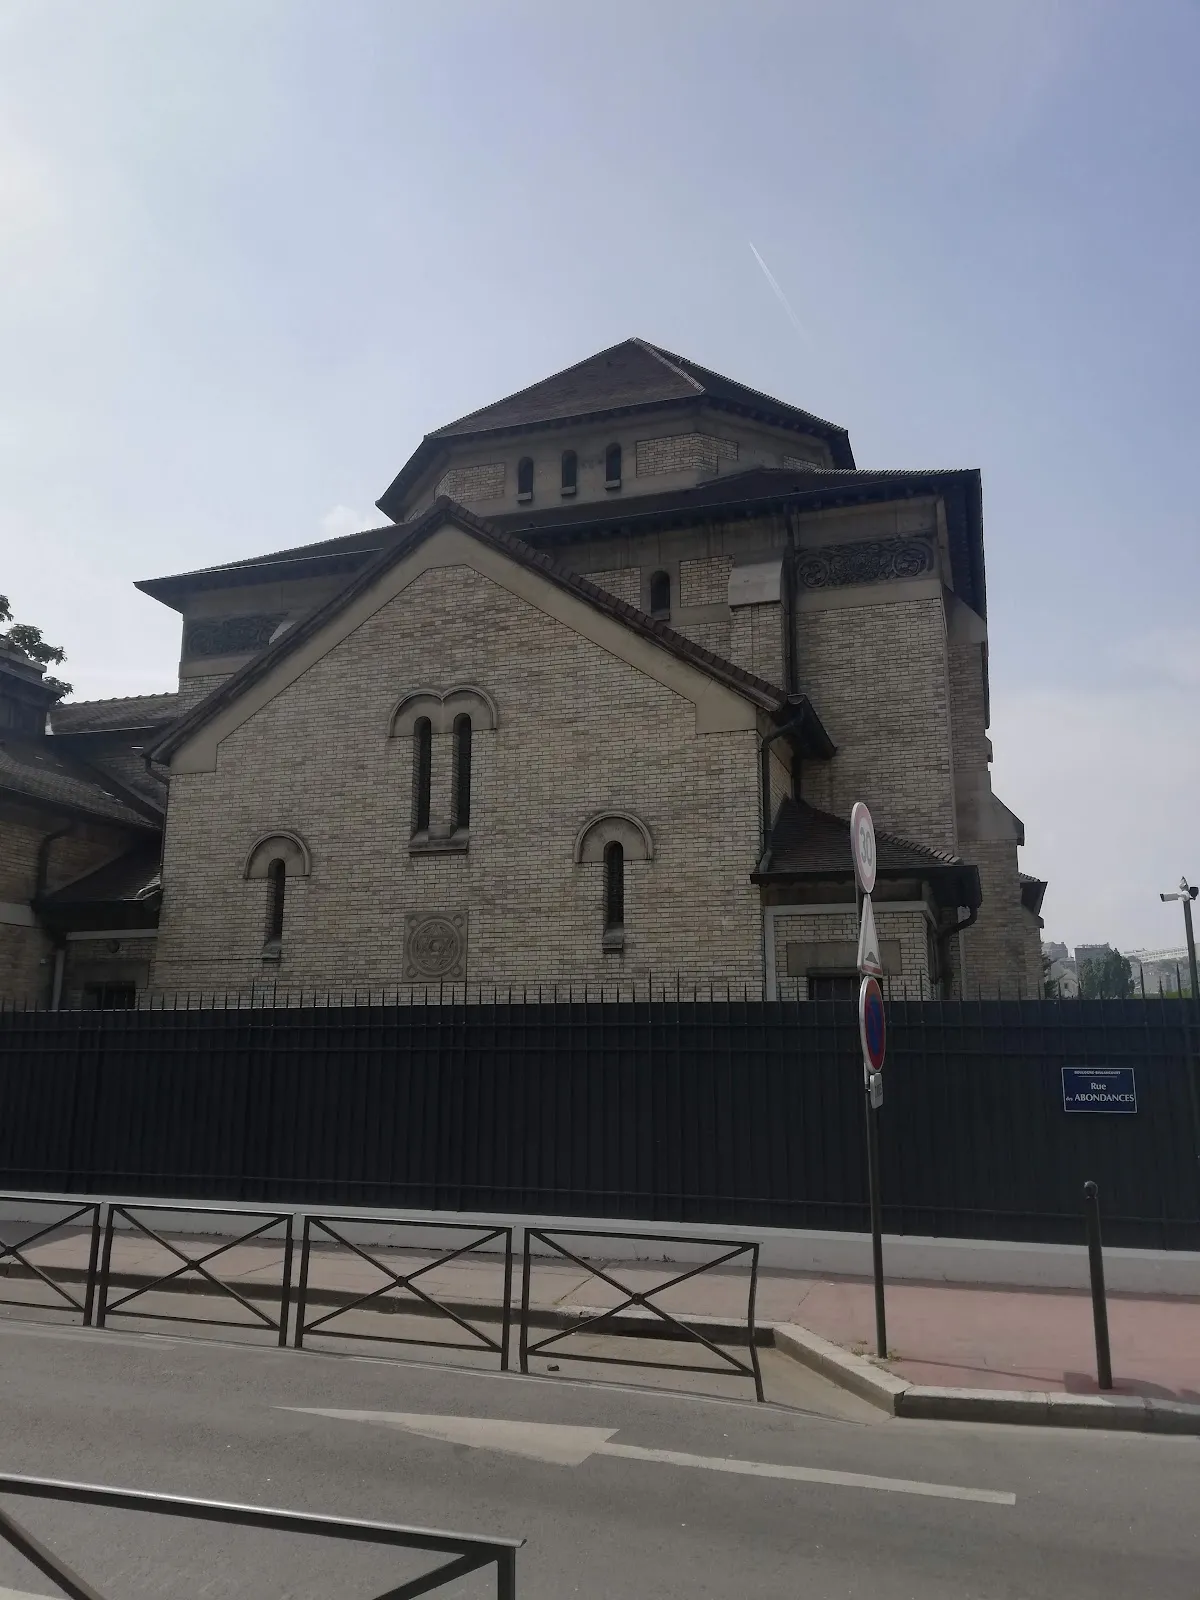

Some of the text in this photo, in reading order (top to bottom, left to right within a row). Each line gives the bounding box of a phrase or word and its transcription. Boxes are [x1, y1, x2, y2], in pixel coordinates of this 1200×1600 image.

[860, 826, 873, 866] 30
[1090, 1082, 1107, 1090] Rue
[1074, 1093, 1135, 1102] ABONDANCES
